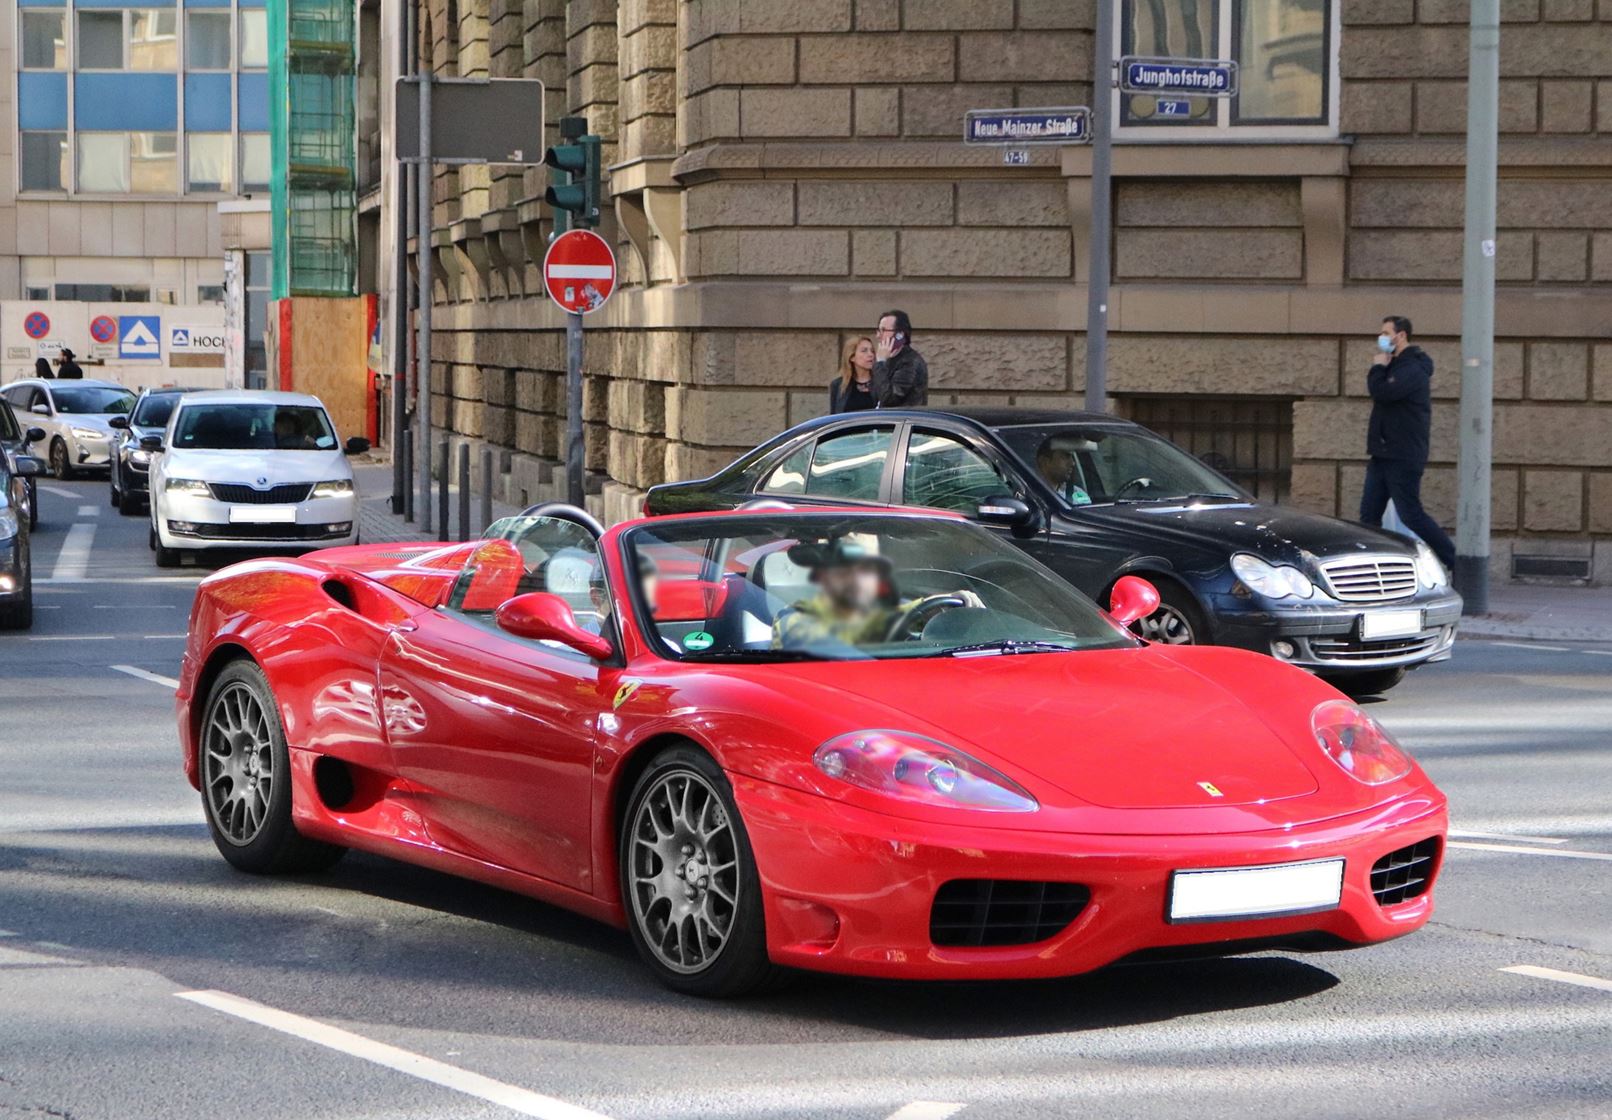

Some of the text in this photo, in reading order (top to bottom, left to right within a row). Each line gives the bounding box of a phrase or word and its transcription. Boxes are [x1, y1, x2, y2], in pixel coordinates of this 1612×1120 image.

[1135, 67, 1224, 89] Junghofstraße
[1164, 102, 1177, 114] 27
[974, 118, 1078, 136] Neue Mainzer Straße
[695, 632, 704, 641] 4
